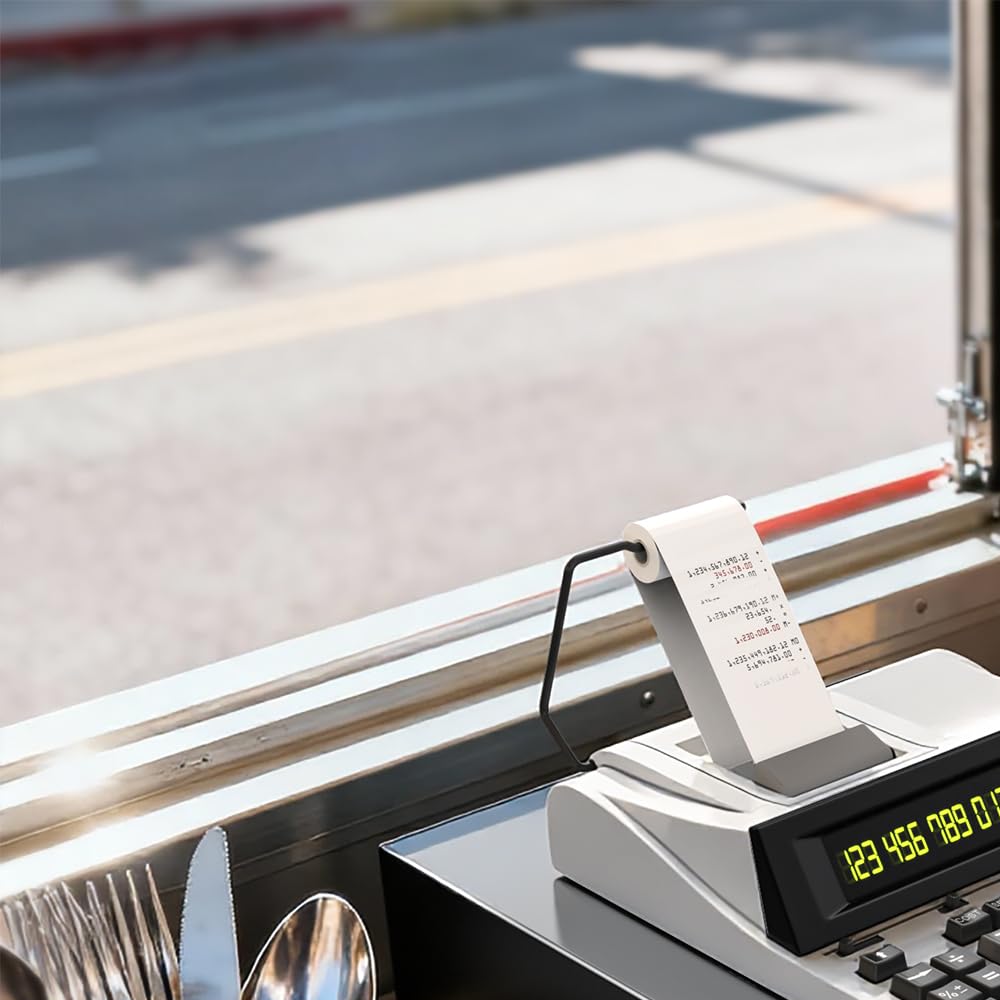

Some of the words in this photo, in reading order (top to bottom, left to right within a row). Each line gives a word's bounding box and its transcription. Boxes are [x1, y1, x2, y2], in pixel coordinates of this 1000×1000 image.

[843, 839, 884, 882] 123
[881, 821, 930, 863] 456
[926, 803, 974, 845] 789
